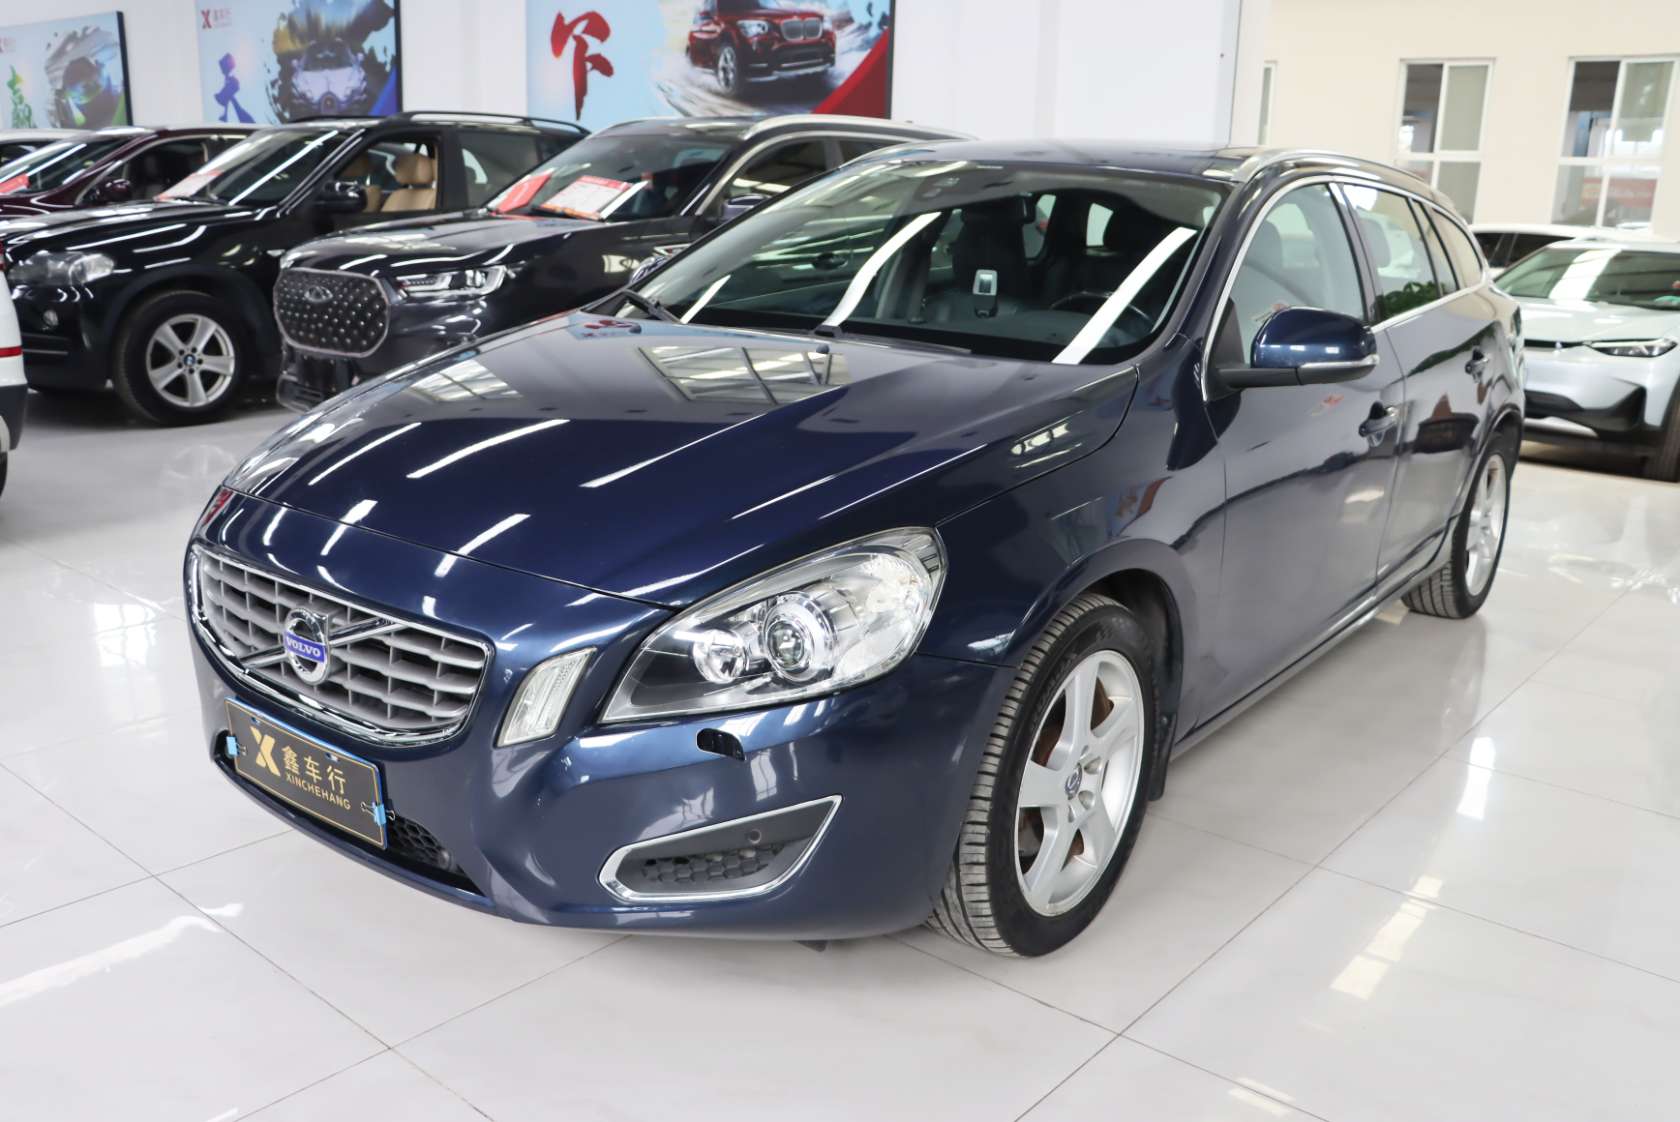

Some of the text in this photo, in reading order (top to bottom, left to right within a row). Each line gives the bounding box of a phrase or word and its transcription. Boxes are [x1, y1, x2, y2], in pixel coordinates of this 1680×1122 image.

[286, 636, 321, 657] VOLVO
[281, 746, 346, 794] 鑫车行
[285, 772, 351, 810] XINCHEHANG
